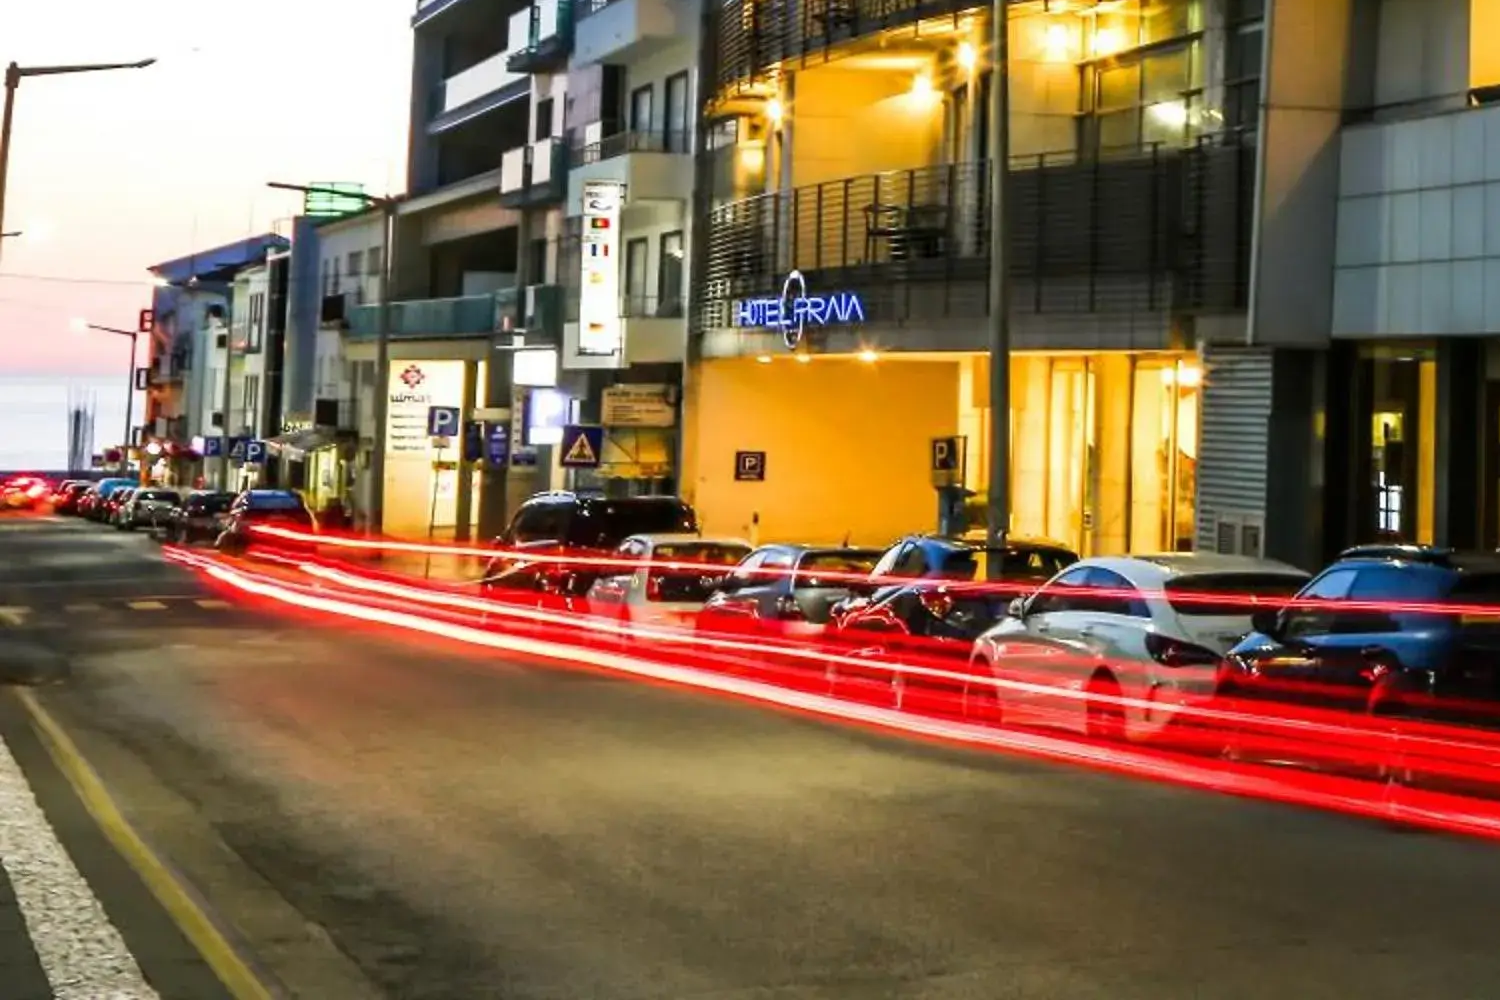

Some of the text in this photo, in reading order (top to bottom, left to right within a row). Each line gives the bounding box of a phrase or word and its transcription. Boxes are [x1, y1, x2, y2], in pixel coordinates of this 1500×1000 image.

[738, 293, 865, 326] HOTEL PRAIA
[433, 409, 453, 433] P
[207, 440, 218, 455] P
[247, 443, 261, 461] P
[935, 442, 948, 468] P
[745, 457, 757, 471] P
